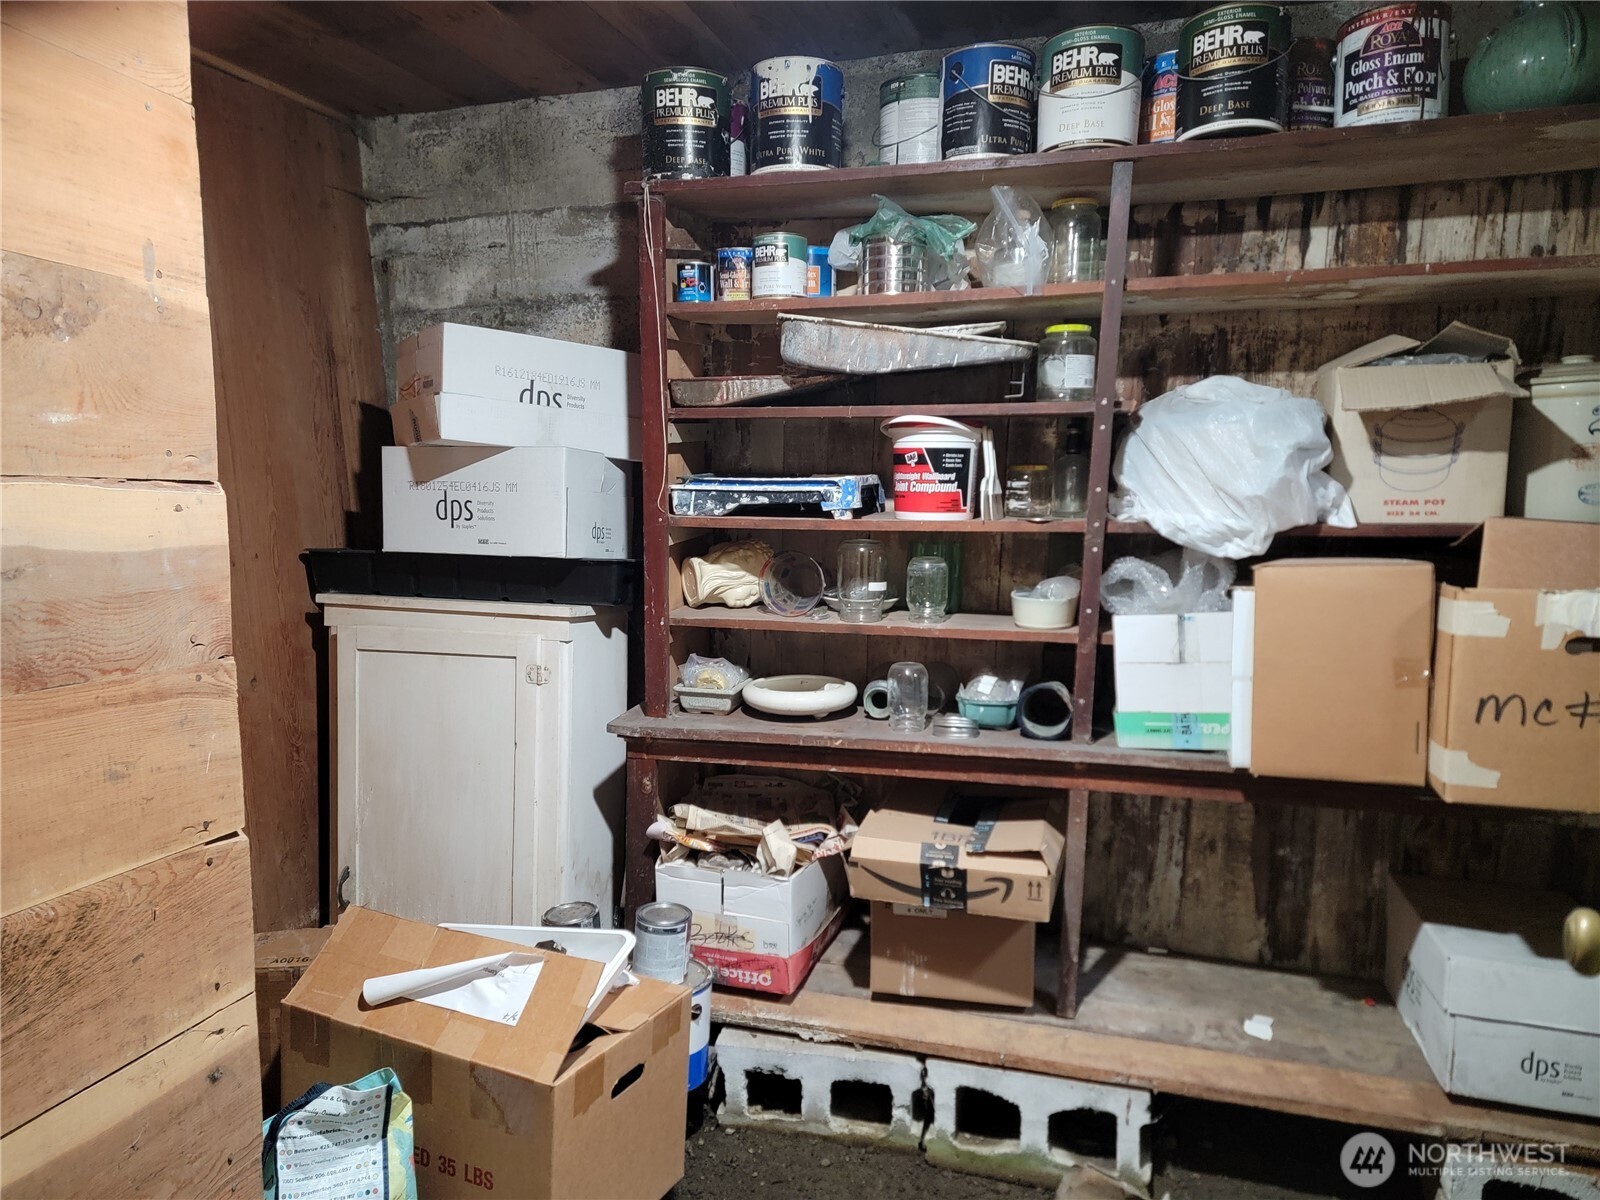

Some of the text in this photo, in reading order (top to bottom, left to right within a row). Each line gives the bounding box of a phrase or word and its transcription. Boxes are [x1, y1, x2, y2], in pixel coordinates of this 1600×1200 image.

[1217, 8, 1242, 17] EXTERIOR
[1203, 14, 1234, 27] SEMI-GLOSS
[1381, 21, 1403, 33] ACE
[1061, 36, 1090, 47] SEMI-GLOSS
[1193, 25, 1244, 57] BEHR
[1370, 31, 1409, 50] ROYA
[1053, 46, 1099, 75] BEHR
[1192, 45, 1264, 68] PREMIUM PLUS
[1351, 51, 1424, 77] Gloss Enam
[993, 64, 1031, 90] BEHR
[1052, 67, 1117, 86] PREMIUM PLUS
[1345, 66, 1437, 100] Porch & Foor
[656, 87, 698, 108] BEHR
[993, 84, 1028, 100] PREMIUM
[760, 97, 818, 110] PREMIUM PLUS
[1153, 99, 1176, 113] Glos
[1200, 100, 1250, 116] DEEP BASE
[656, 107, 715, 119] PREMIUM PLUS
[1058, 119, 1105, 132] DEEP BASE
[1160, 112, 1171, 128] &
[981, 134, 1007, 144] ULTRA
[800, 146, 825, 157] WHITE
[665, 155, 685, 164] DEEP
[755, 246, 776, 258] BEHR
[720, 279, 739, 289] Wall &
[590, 380, 601, 391] MM
[567, 394, 586, 403] Diversity
[567, 402, 585, 410] Products
[922, 472, 956, 481] Wallboard
[506, 482, 518, 492] MM
[910, 481, 958, 494] Compound
[436, 490, 473, 528] dps
[592, 521, 604, 544] dps
[720, 967, 772, 986] Office
[1521, 1051, 1560, 1081] dps
[294, 1147, 318, 1155] Bellevue
[413, 1145, 494, 1190] ED 35 LBS
[295, 1175, 314, 1184] Seattle
